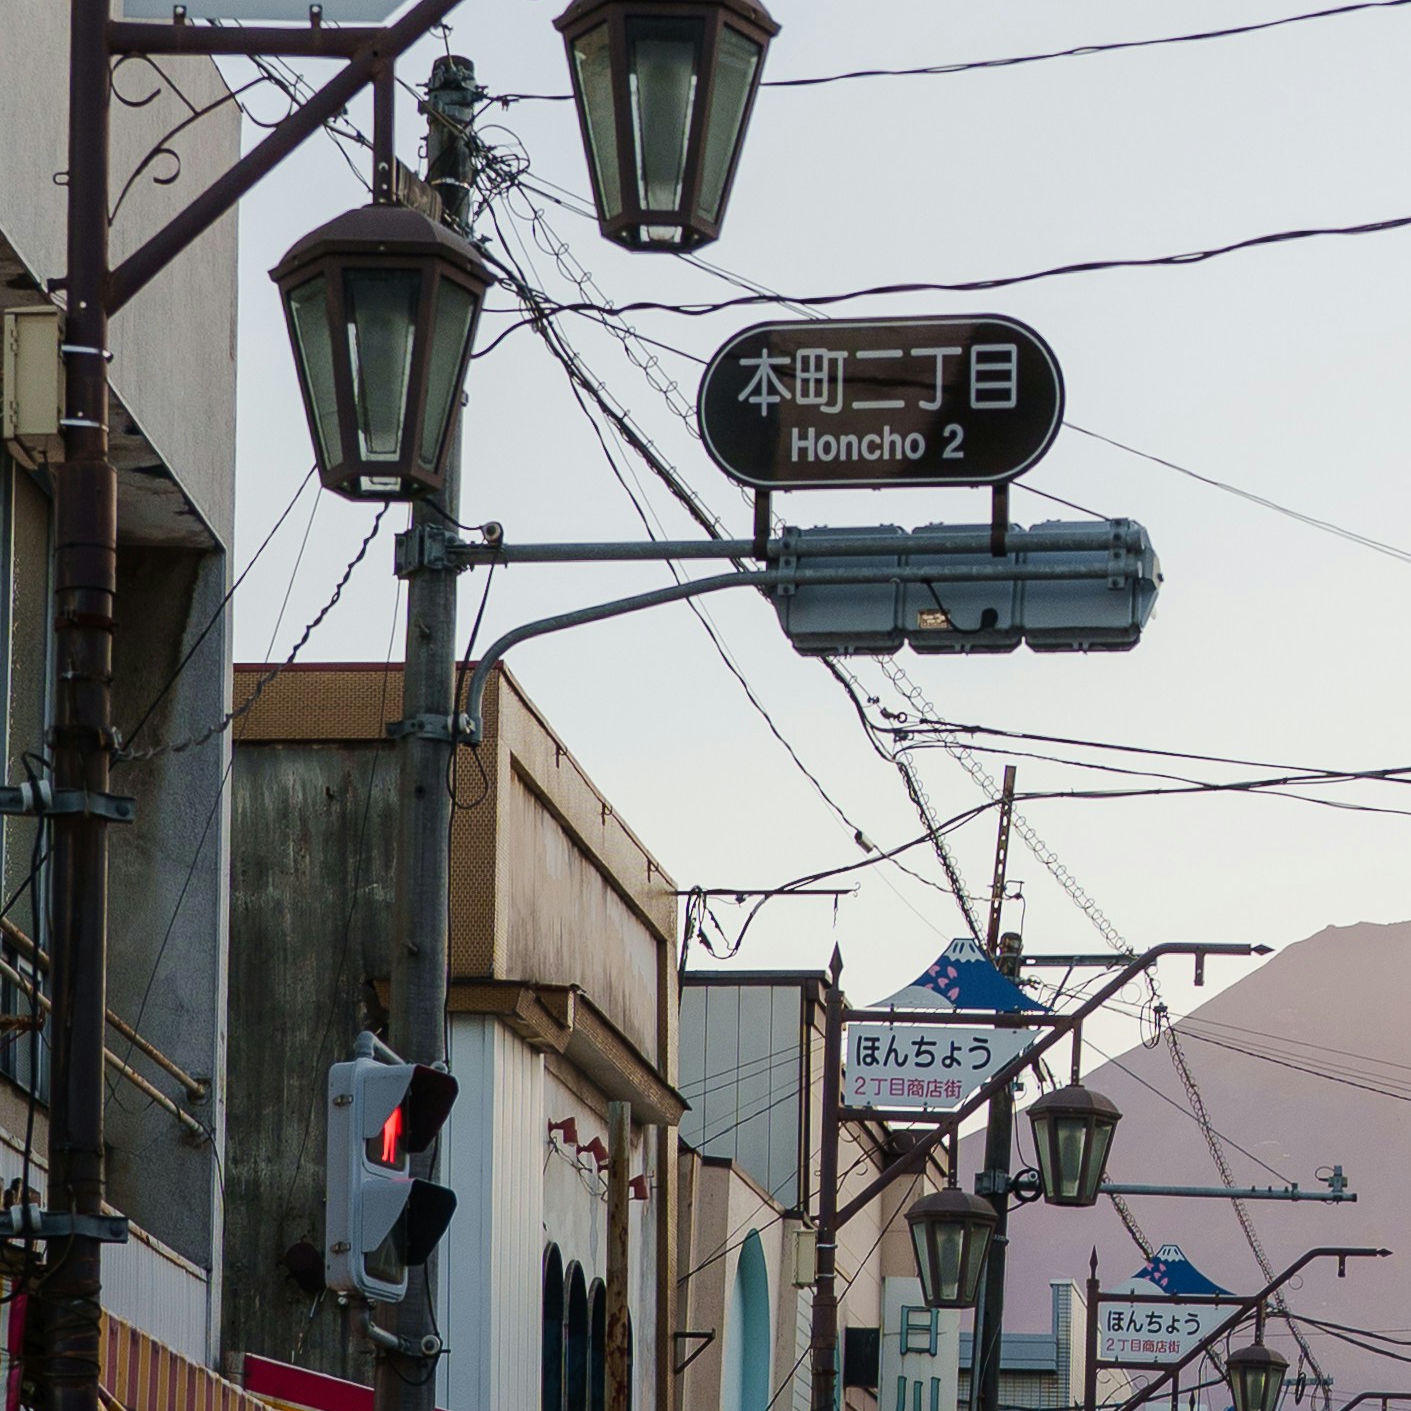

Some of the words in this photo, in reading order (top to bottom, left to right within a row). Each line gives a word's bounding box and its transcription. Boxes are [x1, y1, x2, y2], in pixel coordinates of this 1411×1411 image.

[737, 342, 1018, 417] 本町二丁目
[790, 425, 926, 462] Honcho
[942, 423, 964, 459] 2
[854, 1034, 992, 1072] ほんちょう
[854, 1077, 963, 1100] 2丁目商店街
[1106, 1309, 1202, 1336] ほんちょう
[1105, 1337, 1181, 1355] 2丁目商店街
